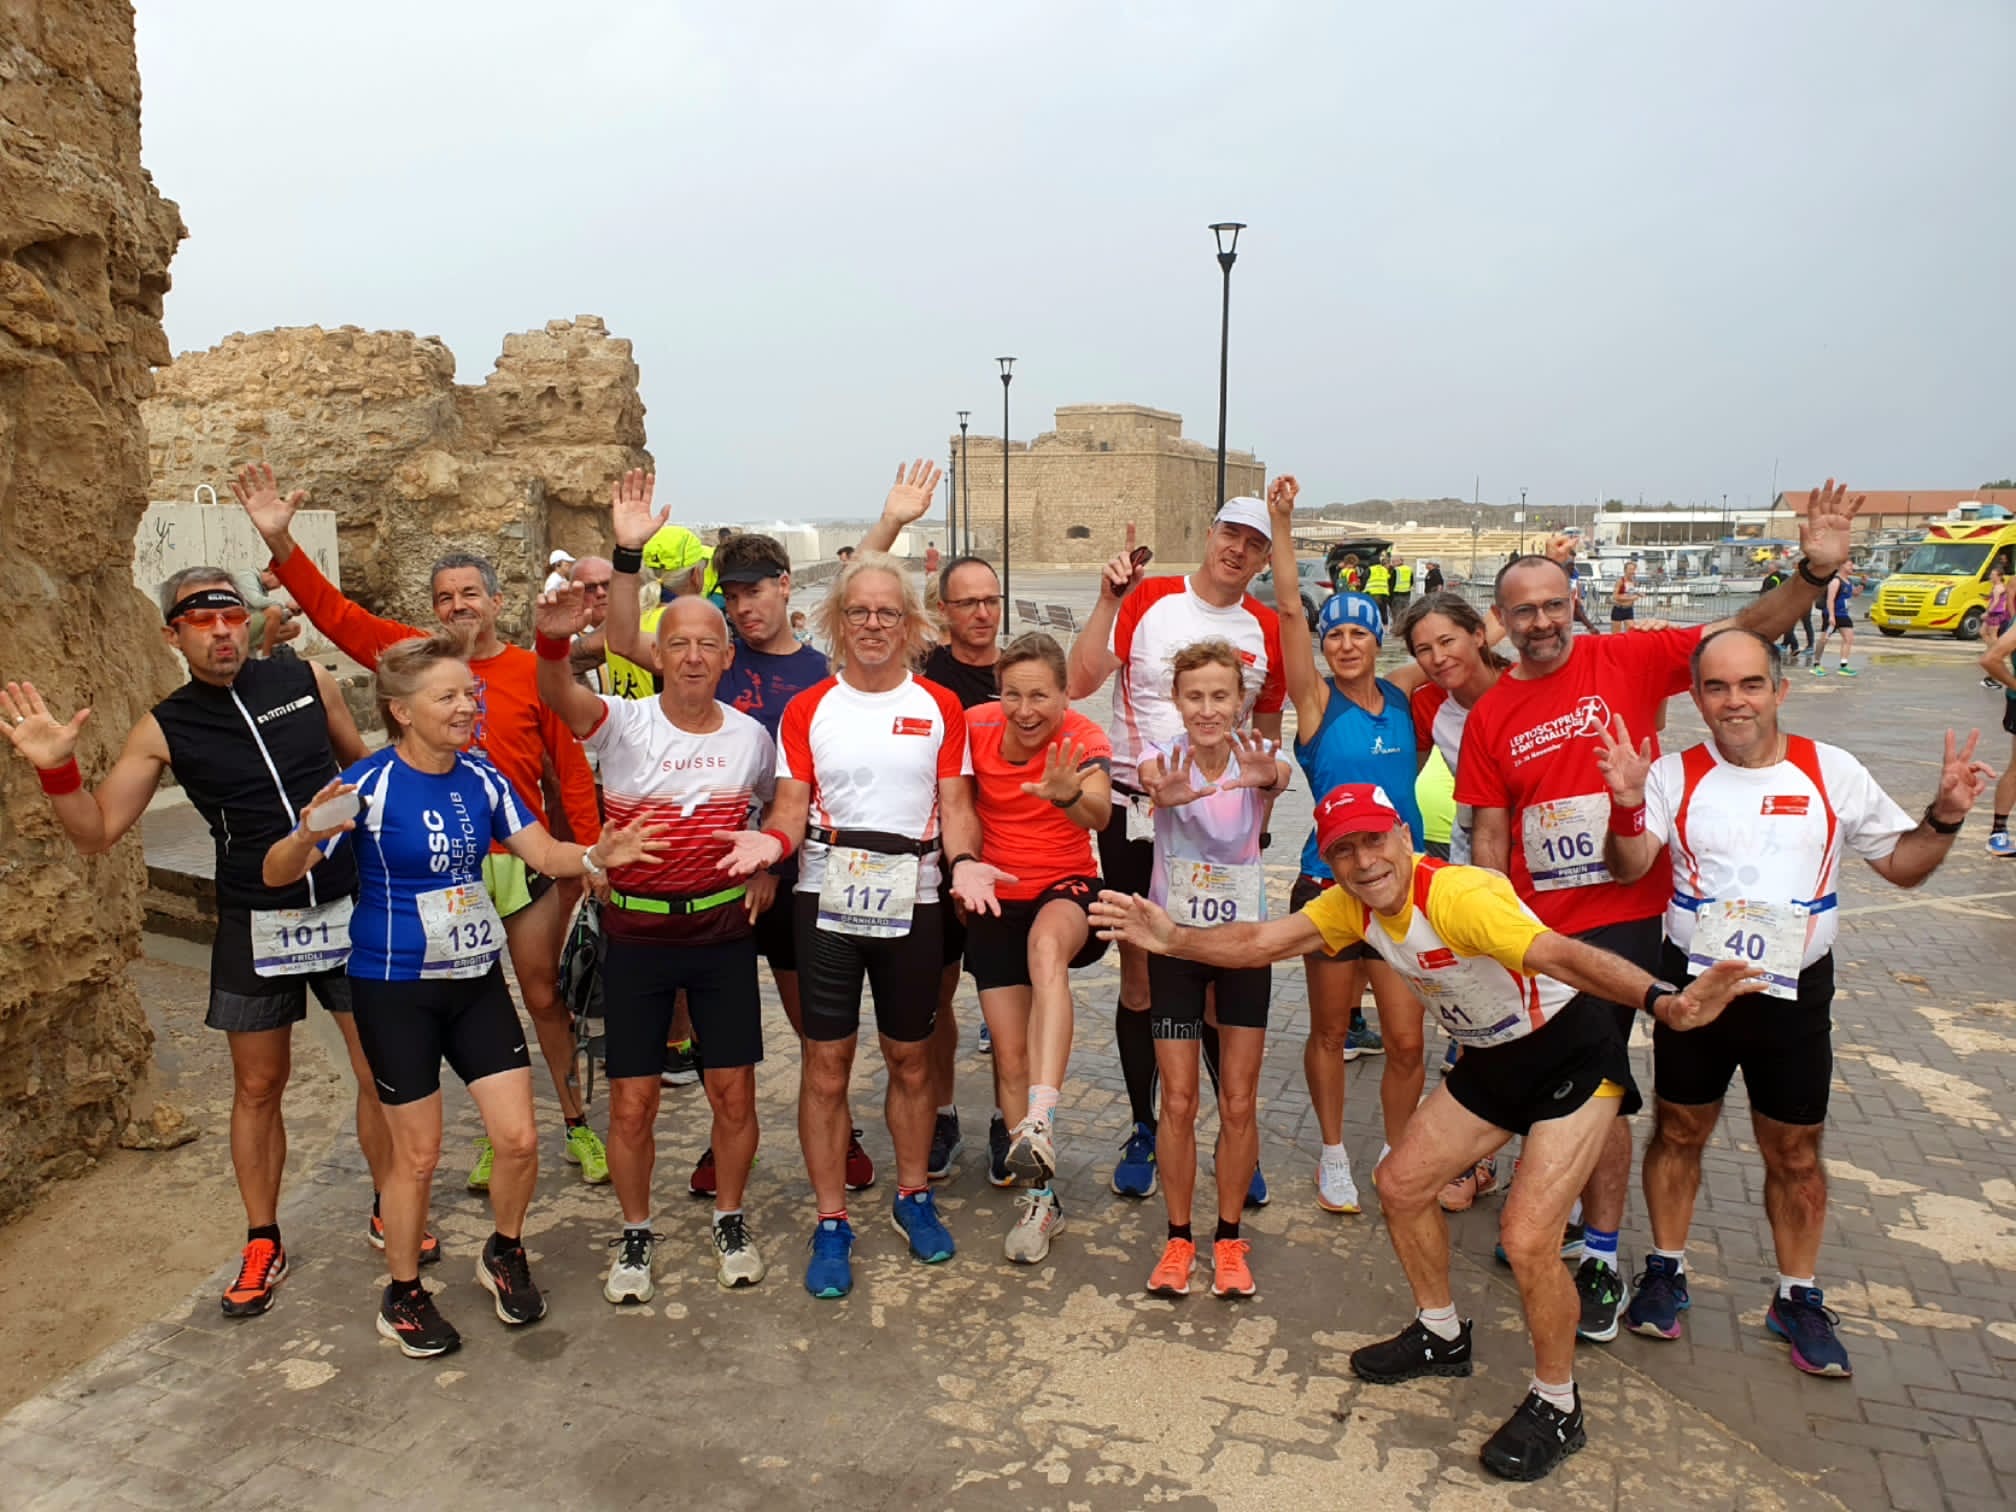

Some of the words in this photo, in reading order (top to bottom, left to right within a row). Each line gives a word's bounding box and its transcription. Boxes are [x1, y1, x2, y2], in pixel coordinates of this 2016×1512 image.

[662, 757, 727, 772] SUISSE
[422, 808, 450, 873] SSC
[1541, 832, 1594, 863] 106
[843, 884, 892, 911] 117
[1188, 895, 1237, 922] 109
[275, 921, 329, 948] 101
[448, 919, 493, 952] 132
[1724, 929, 1766, 960] 40
[1440, 1004, 1472, 1025] 41
